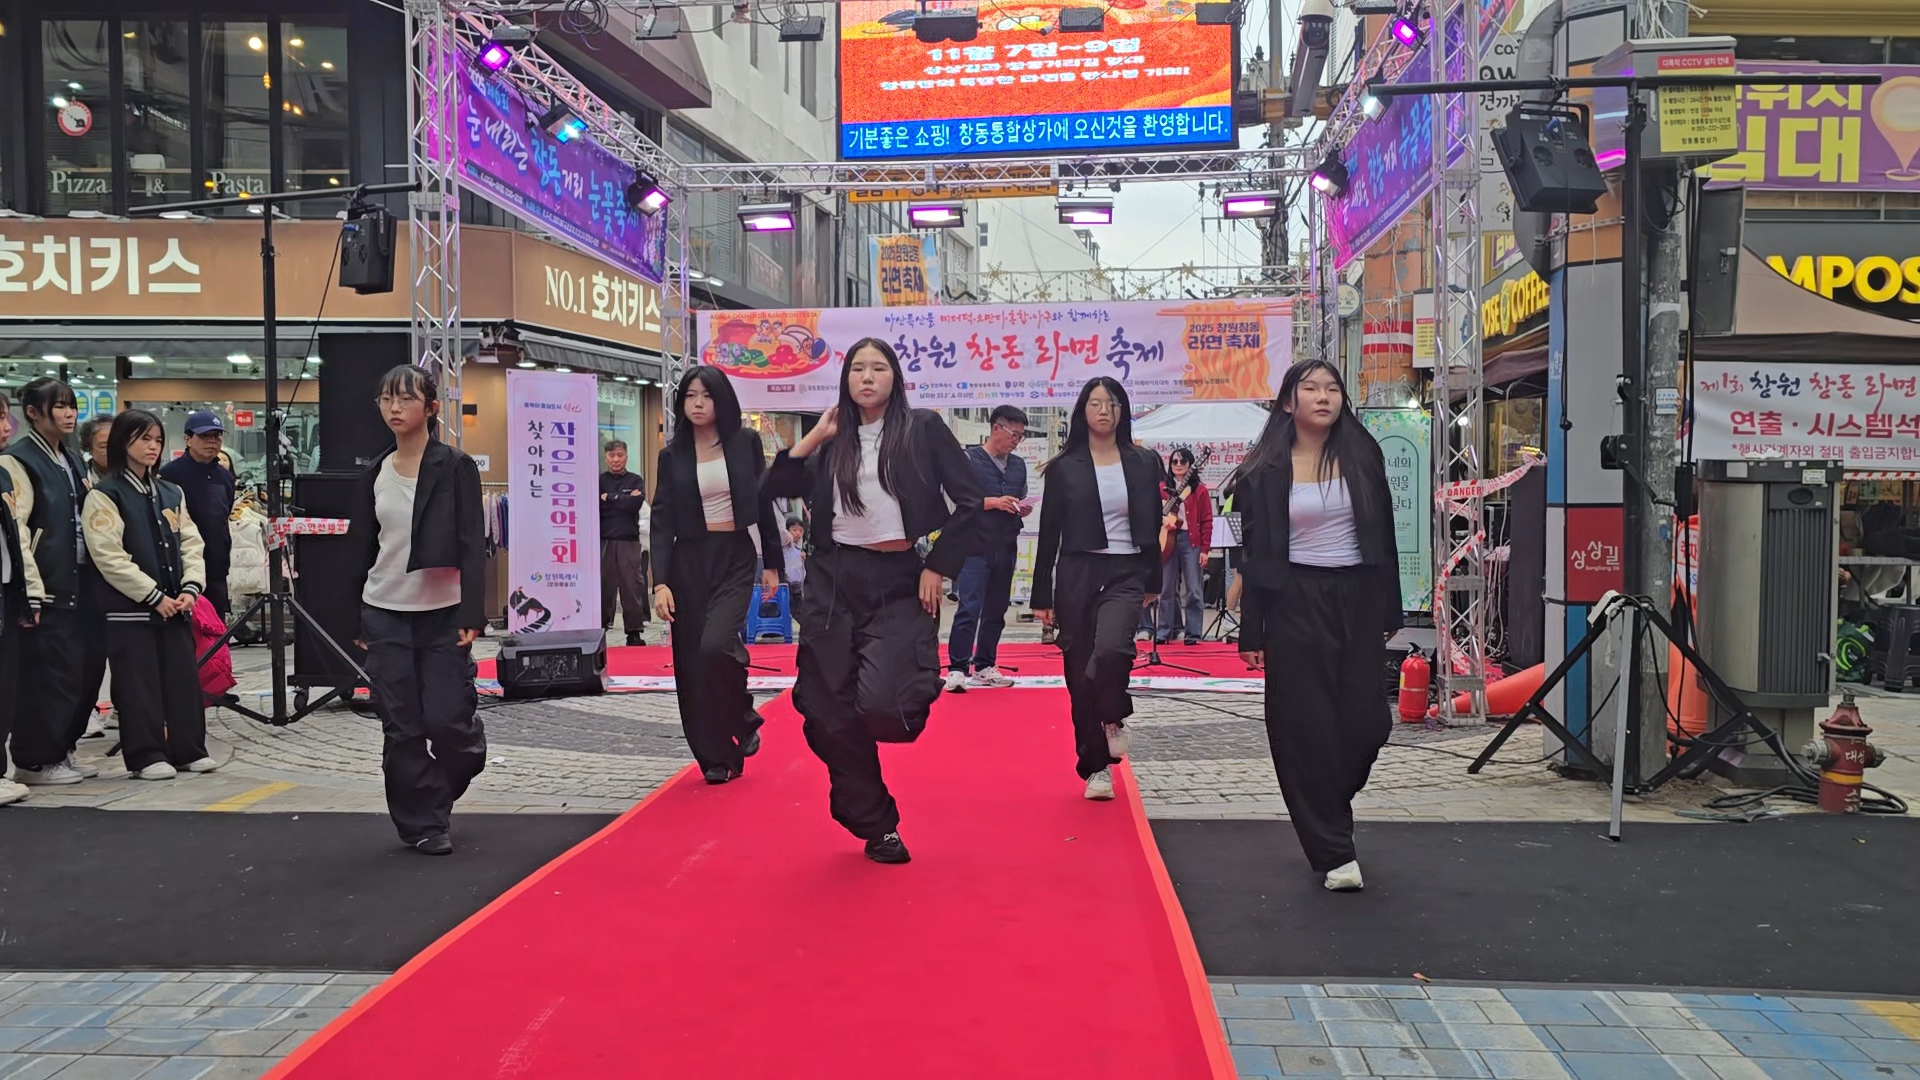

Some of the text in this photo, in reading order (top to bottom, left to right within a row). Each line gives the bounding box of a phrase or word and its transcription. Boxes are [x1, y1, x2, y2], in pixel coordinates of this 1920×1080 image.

[1682, 58, 1702, 66] CCTV
[848, 111, 1228, 150] 기분좋은 쇼핑! 창동통합상가에 오신것을 환영합니다.
[51, 171, 265, 194] Pizza & Pasta
[0, 234, 201, 295] 호치키스
[545, 265, 662, 332] NO.1 호치키스
[1068, 309, 1110, 324] 함께하는
[1189, 322, 1260, 333] 2025 창원창동
[1482, 294, 1501, 338] OSE
[1188, 333, 1260, 350] 라면 축제
[894, 327, 1164, 396] 창원 창동 라면 축제
[1700, 370, 1917, 416] 제1회 창원 창동 라면
[1730, 410, 1920, 439] 연출 시스템석
[527, 419, 545, 499] 찾아가는
[1819, 445, 1844, 458] 절대
[1387, 475, 1409, 491] 원을
[1447, 486, 1484, 497] DANGER!
[1571, 541, 1620, 569] 상상길
